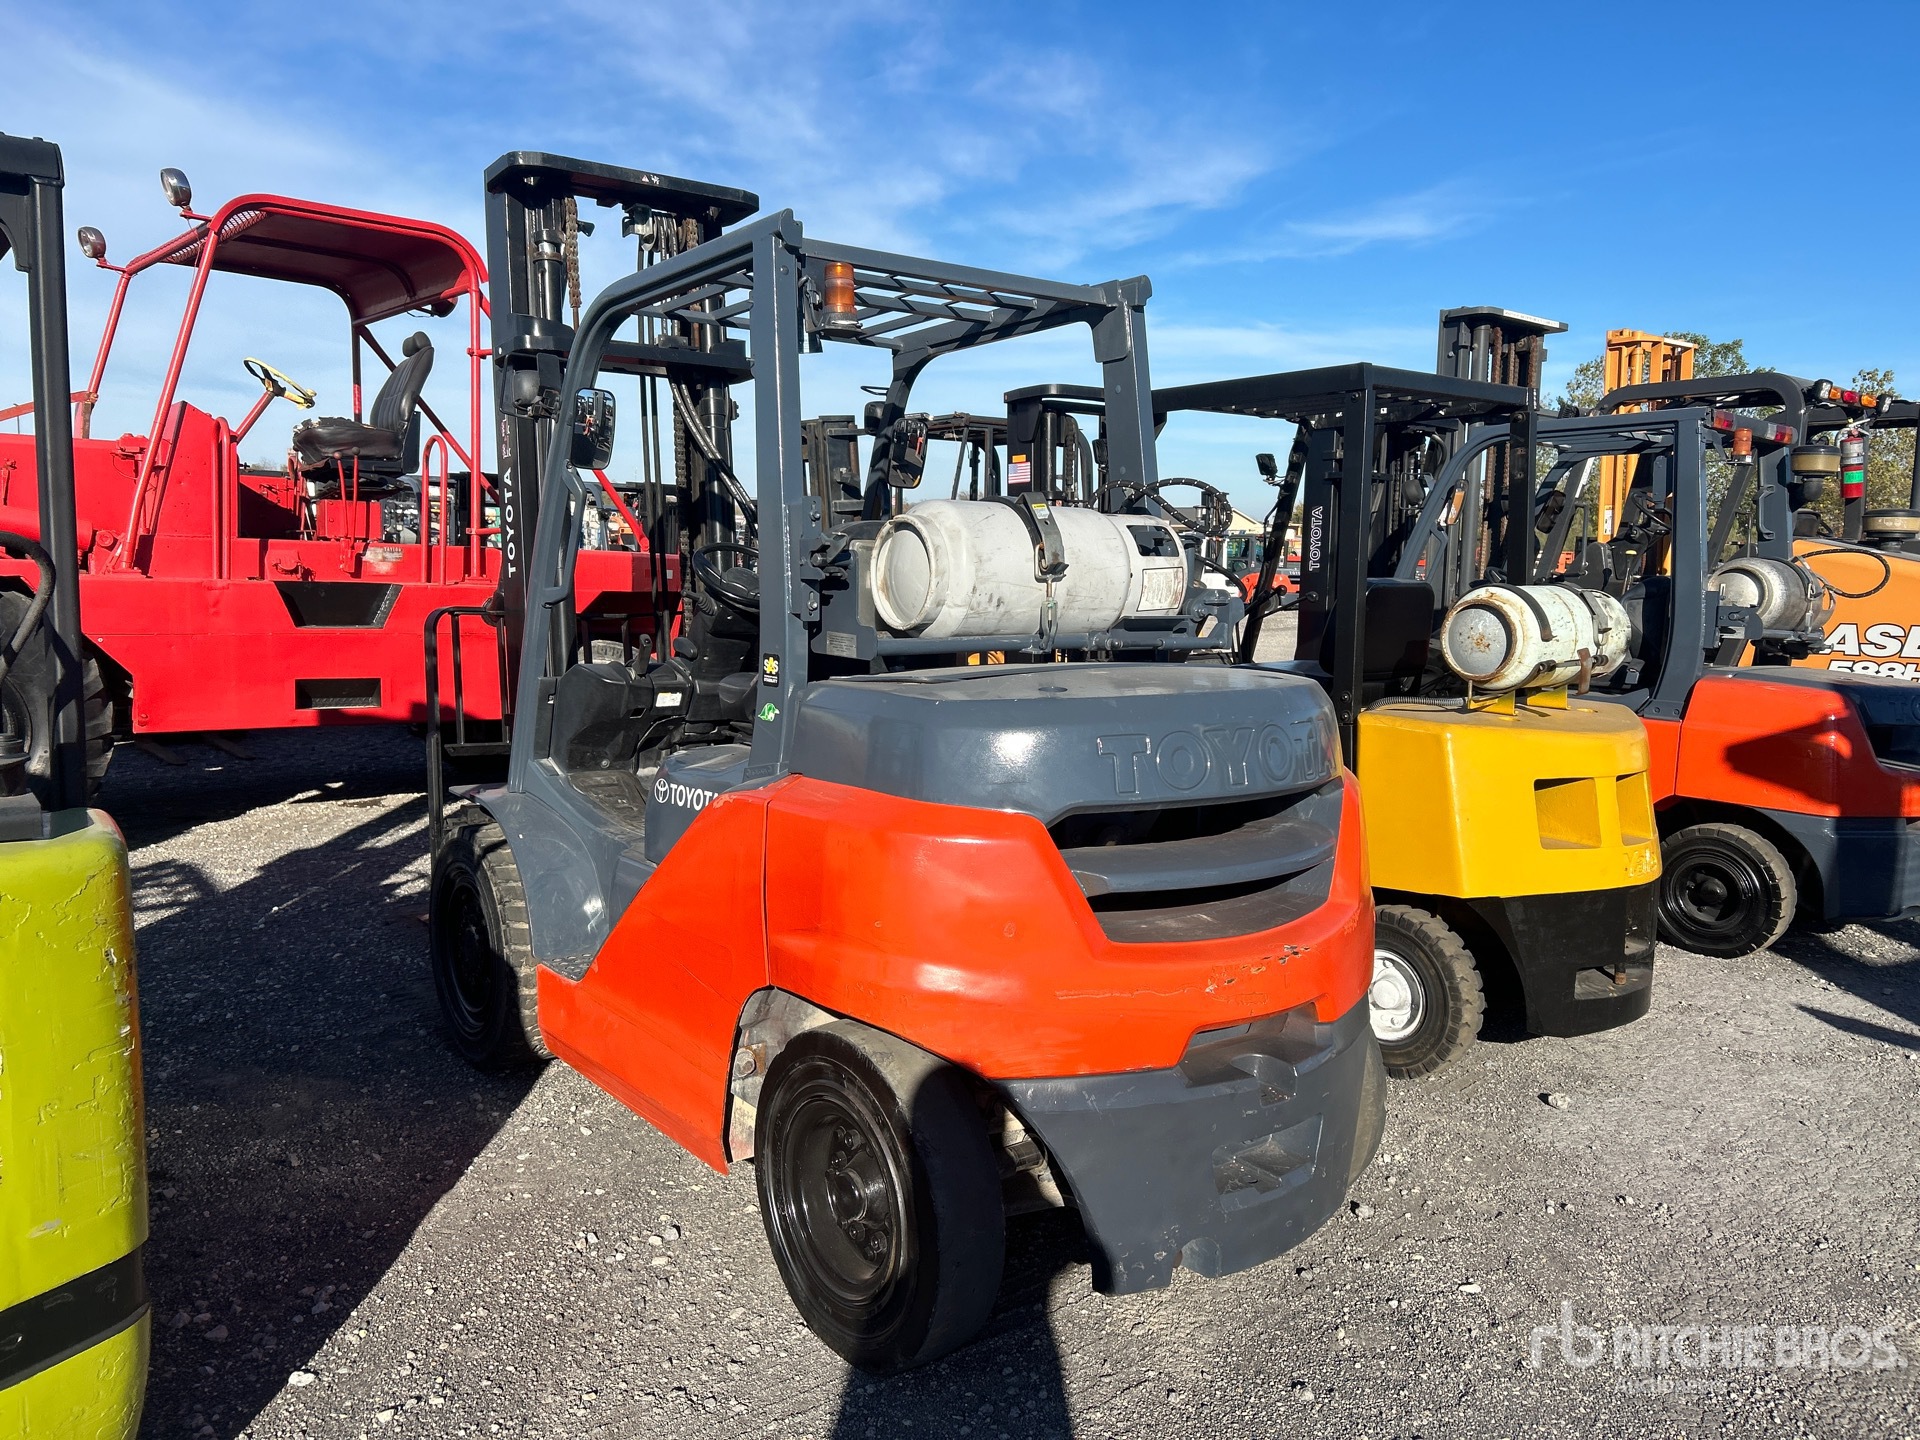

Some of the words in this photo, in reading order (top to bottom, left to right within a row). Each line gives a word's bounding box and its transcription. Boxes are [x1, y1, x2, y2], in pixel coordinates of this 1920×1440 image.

[503, 467, 517, 578] TOYOTA
[1309, 506, 1323, 572] TOYOTA
[764, 656, 779, 675] SAS
[1818, 623, 1920, 658] AS
[1097, 716, 1337, 796] TOYOTA
[670, 782, 719, 811] TOYOT
